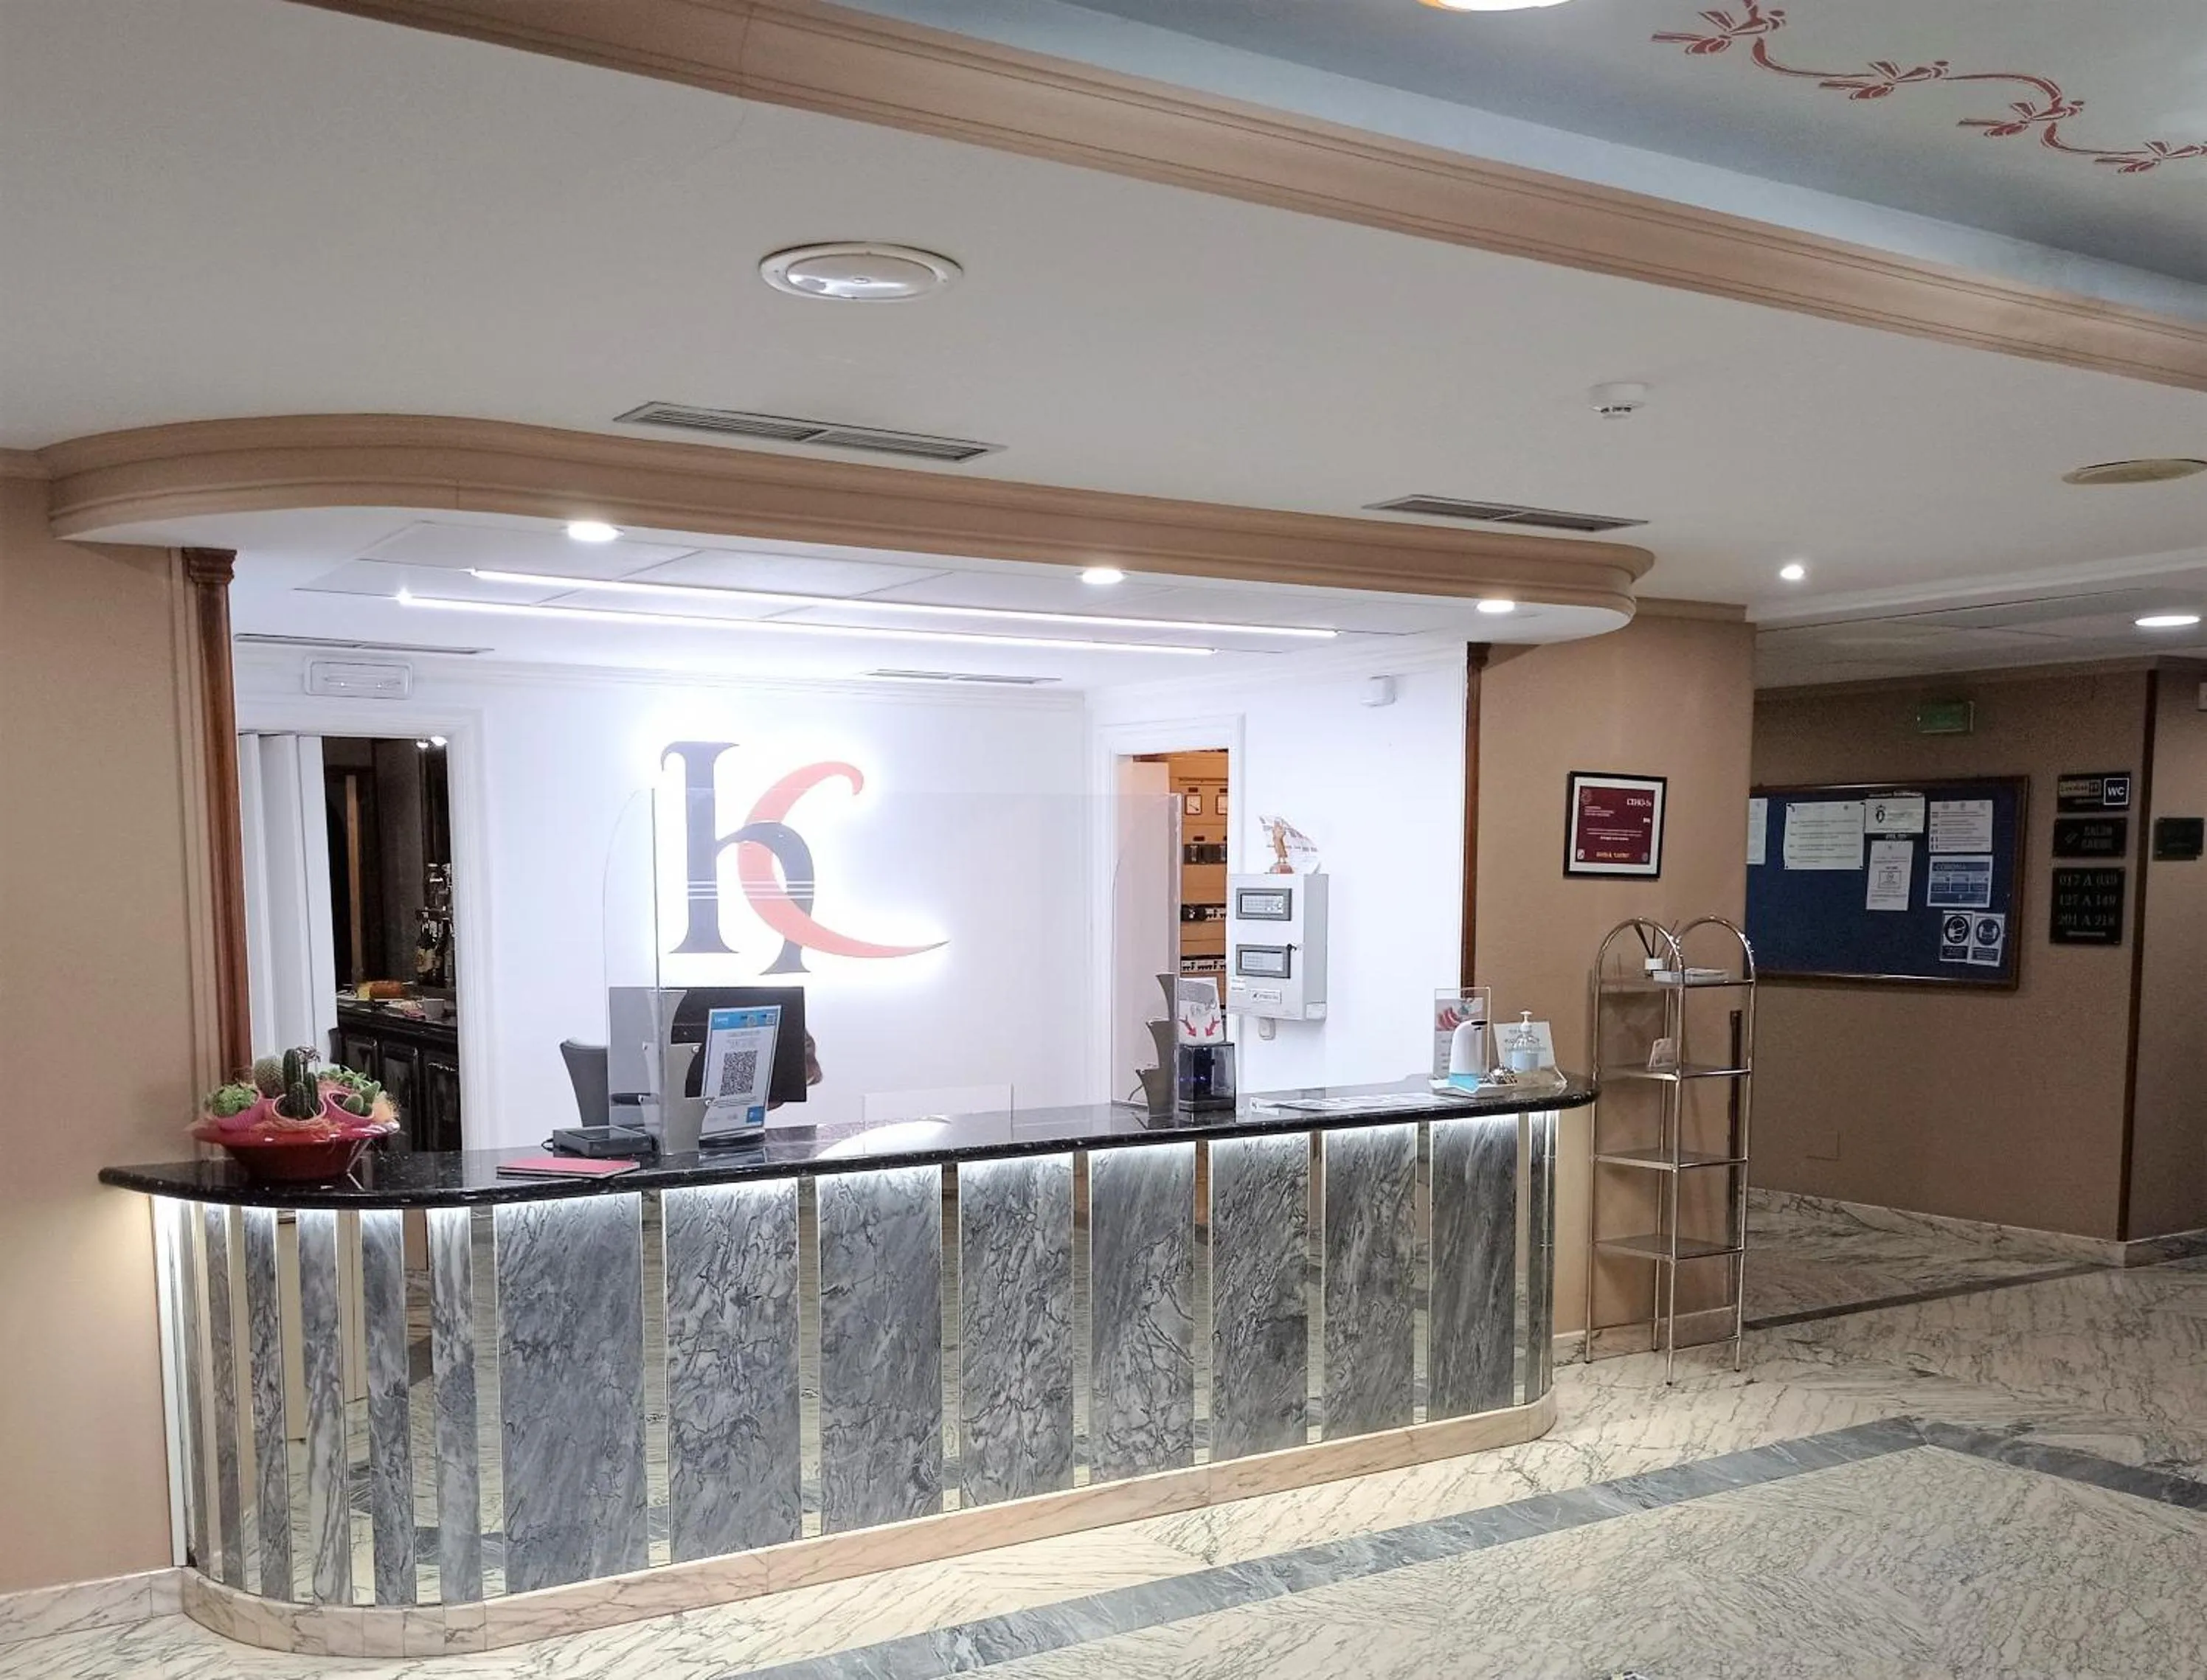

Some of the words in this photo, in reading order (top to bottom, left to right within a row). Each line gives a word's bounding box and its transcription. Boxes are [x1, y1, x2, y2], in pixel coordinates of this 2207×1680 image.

[2107, 786, 2124, 796] WC
[2082, 895, 2092, 906] A
[2081, 914, 2091, 926] A
